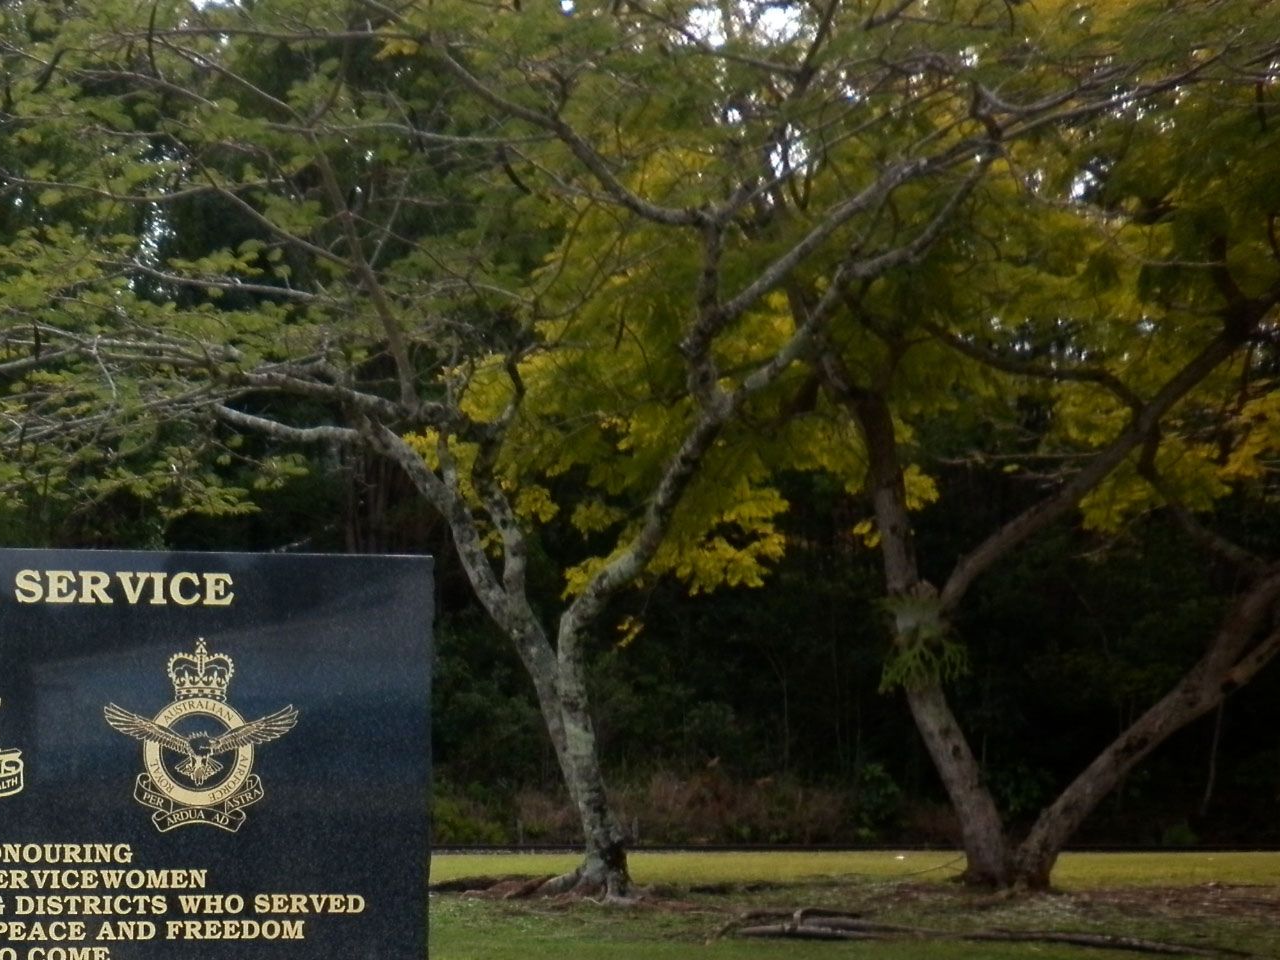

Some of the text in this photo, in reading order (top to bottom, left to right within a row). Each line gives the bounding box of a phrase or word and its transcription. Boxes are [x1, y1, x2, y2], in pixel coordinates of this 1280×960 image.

[14, 568, 235, 606] SERVICE
[149, 759, 174, 793] ROYAL
[164, 700, 234, 722] AUSTRALIAN
[143, 790, 261, 826] PER ARDUA AD ASTRA
[14, 894, 168, 916] DISTRICTS
[177, 894, 245, 914] WHO
[254, 893, 366, 914] SERVED
[95, 920, 156, 941] AND
[165, 919, 306, 940] FREEDOM
